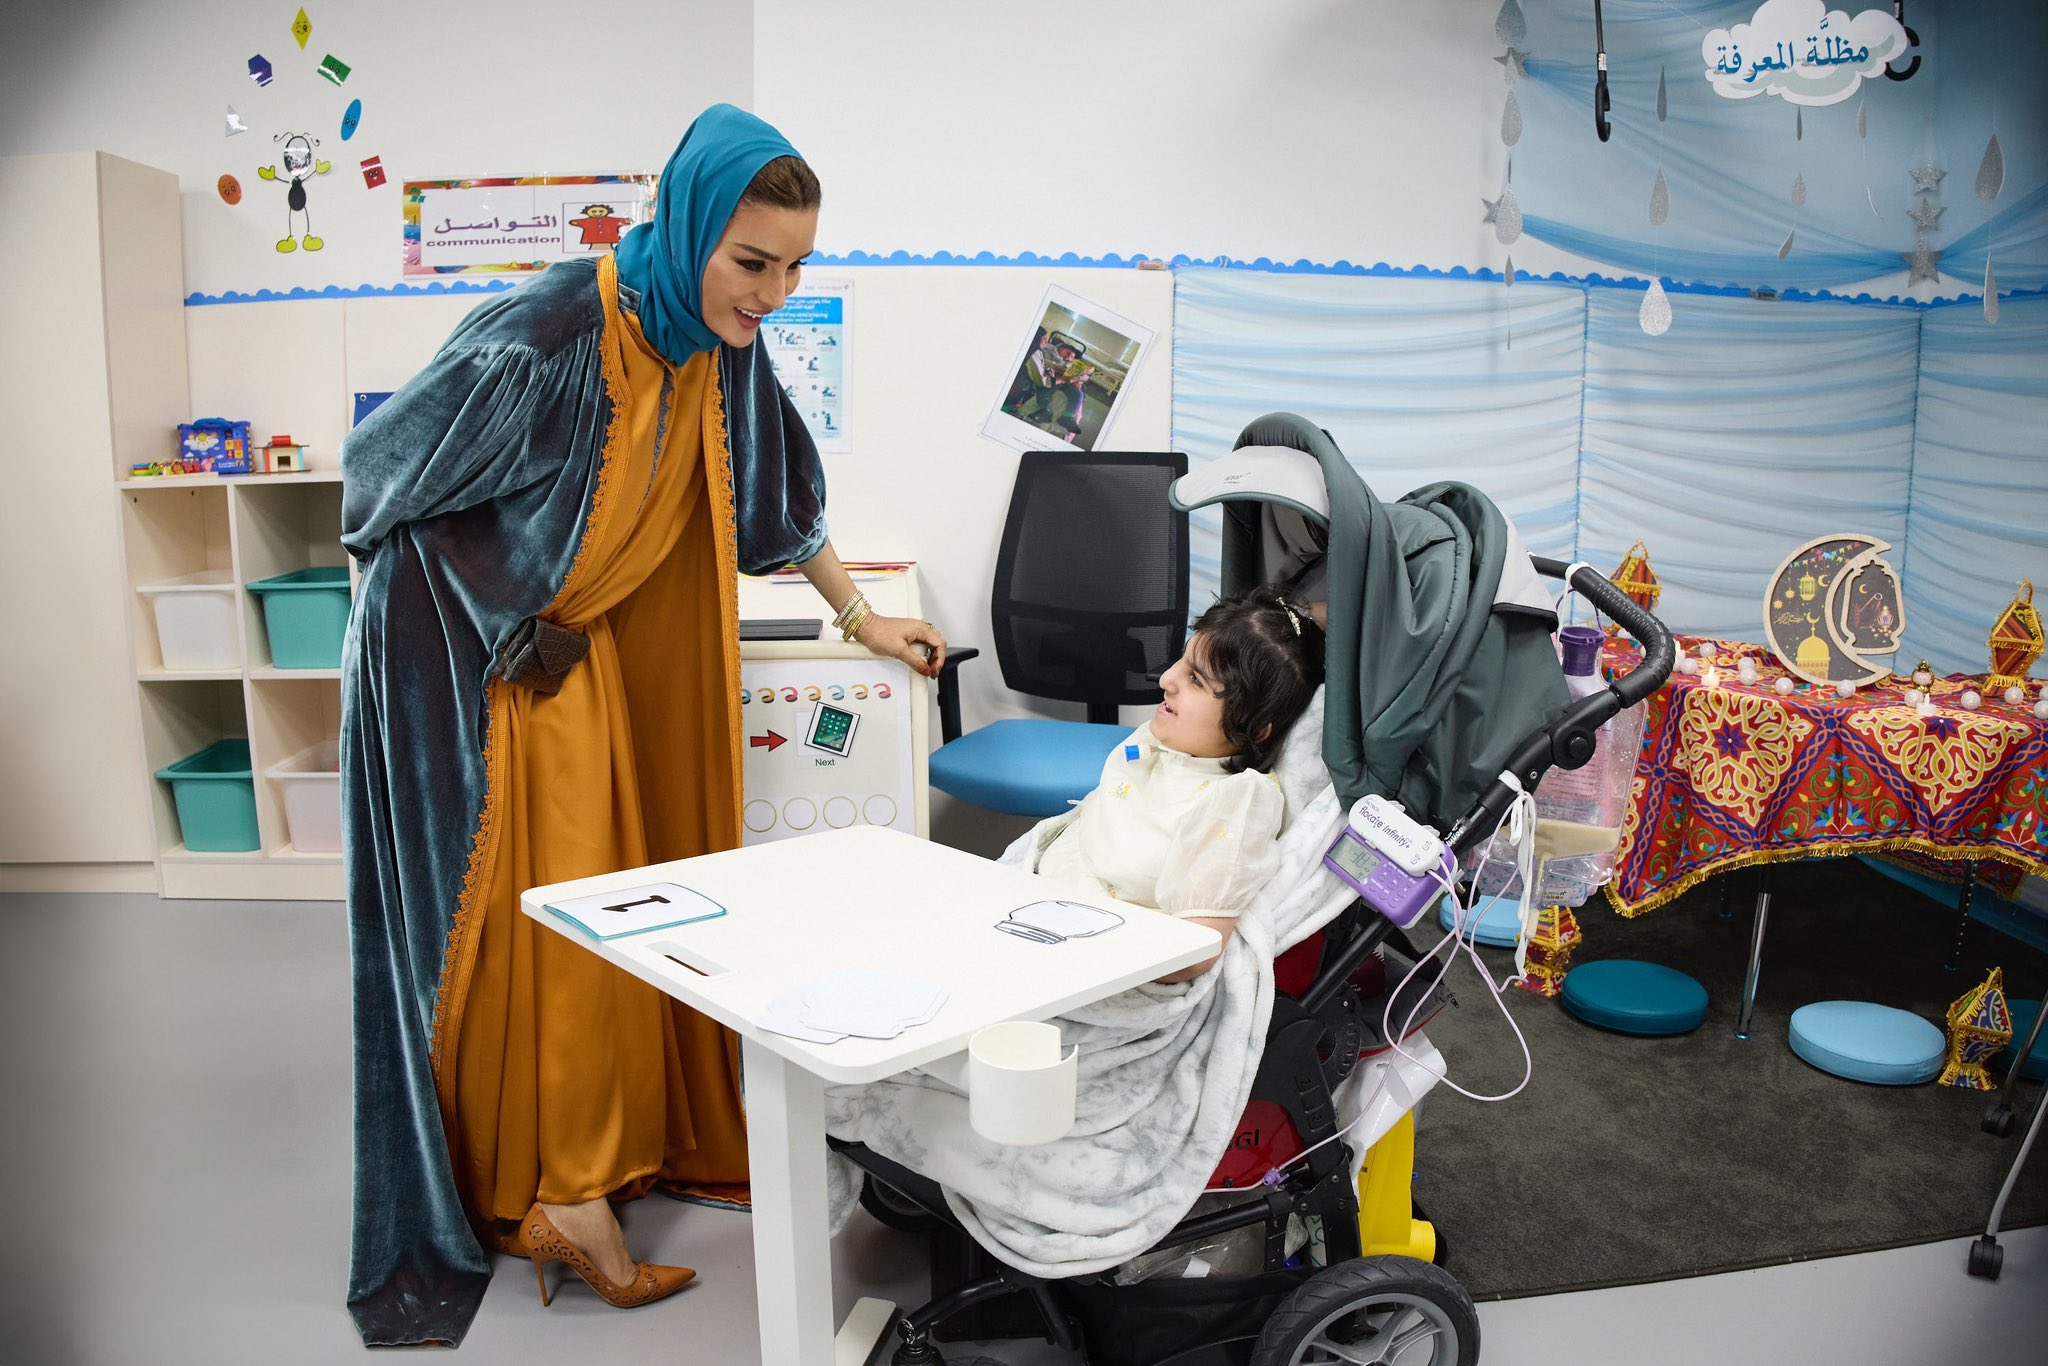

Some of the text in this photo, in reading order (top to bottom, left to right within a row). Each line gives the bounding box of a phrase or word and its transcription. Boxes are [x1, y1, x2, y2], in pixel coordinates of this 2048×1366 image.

[1717, 41, 1795, 83] المعرفة
[434, 214, 557, 234] التواصل
[426, 236, 561, 247] communication
[815, 758, 836, 767] Next
[601, 894, 671, 912] 1
